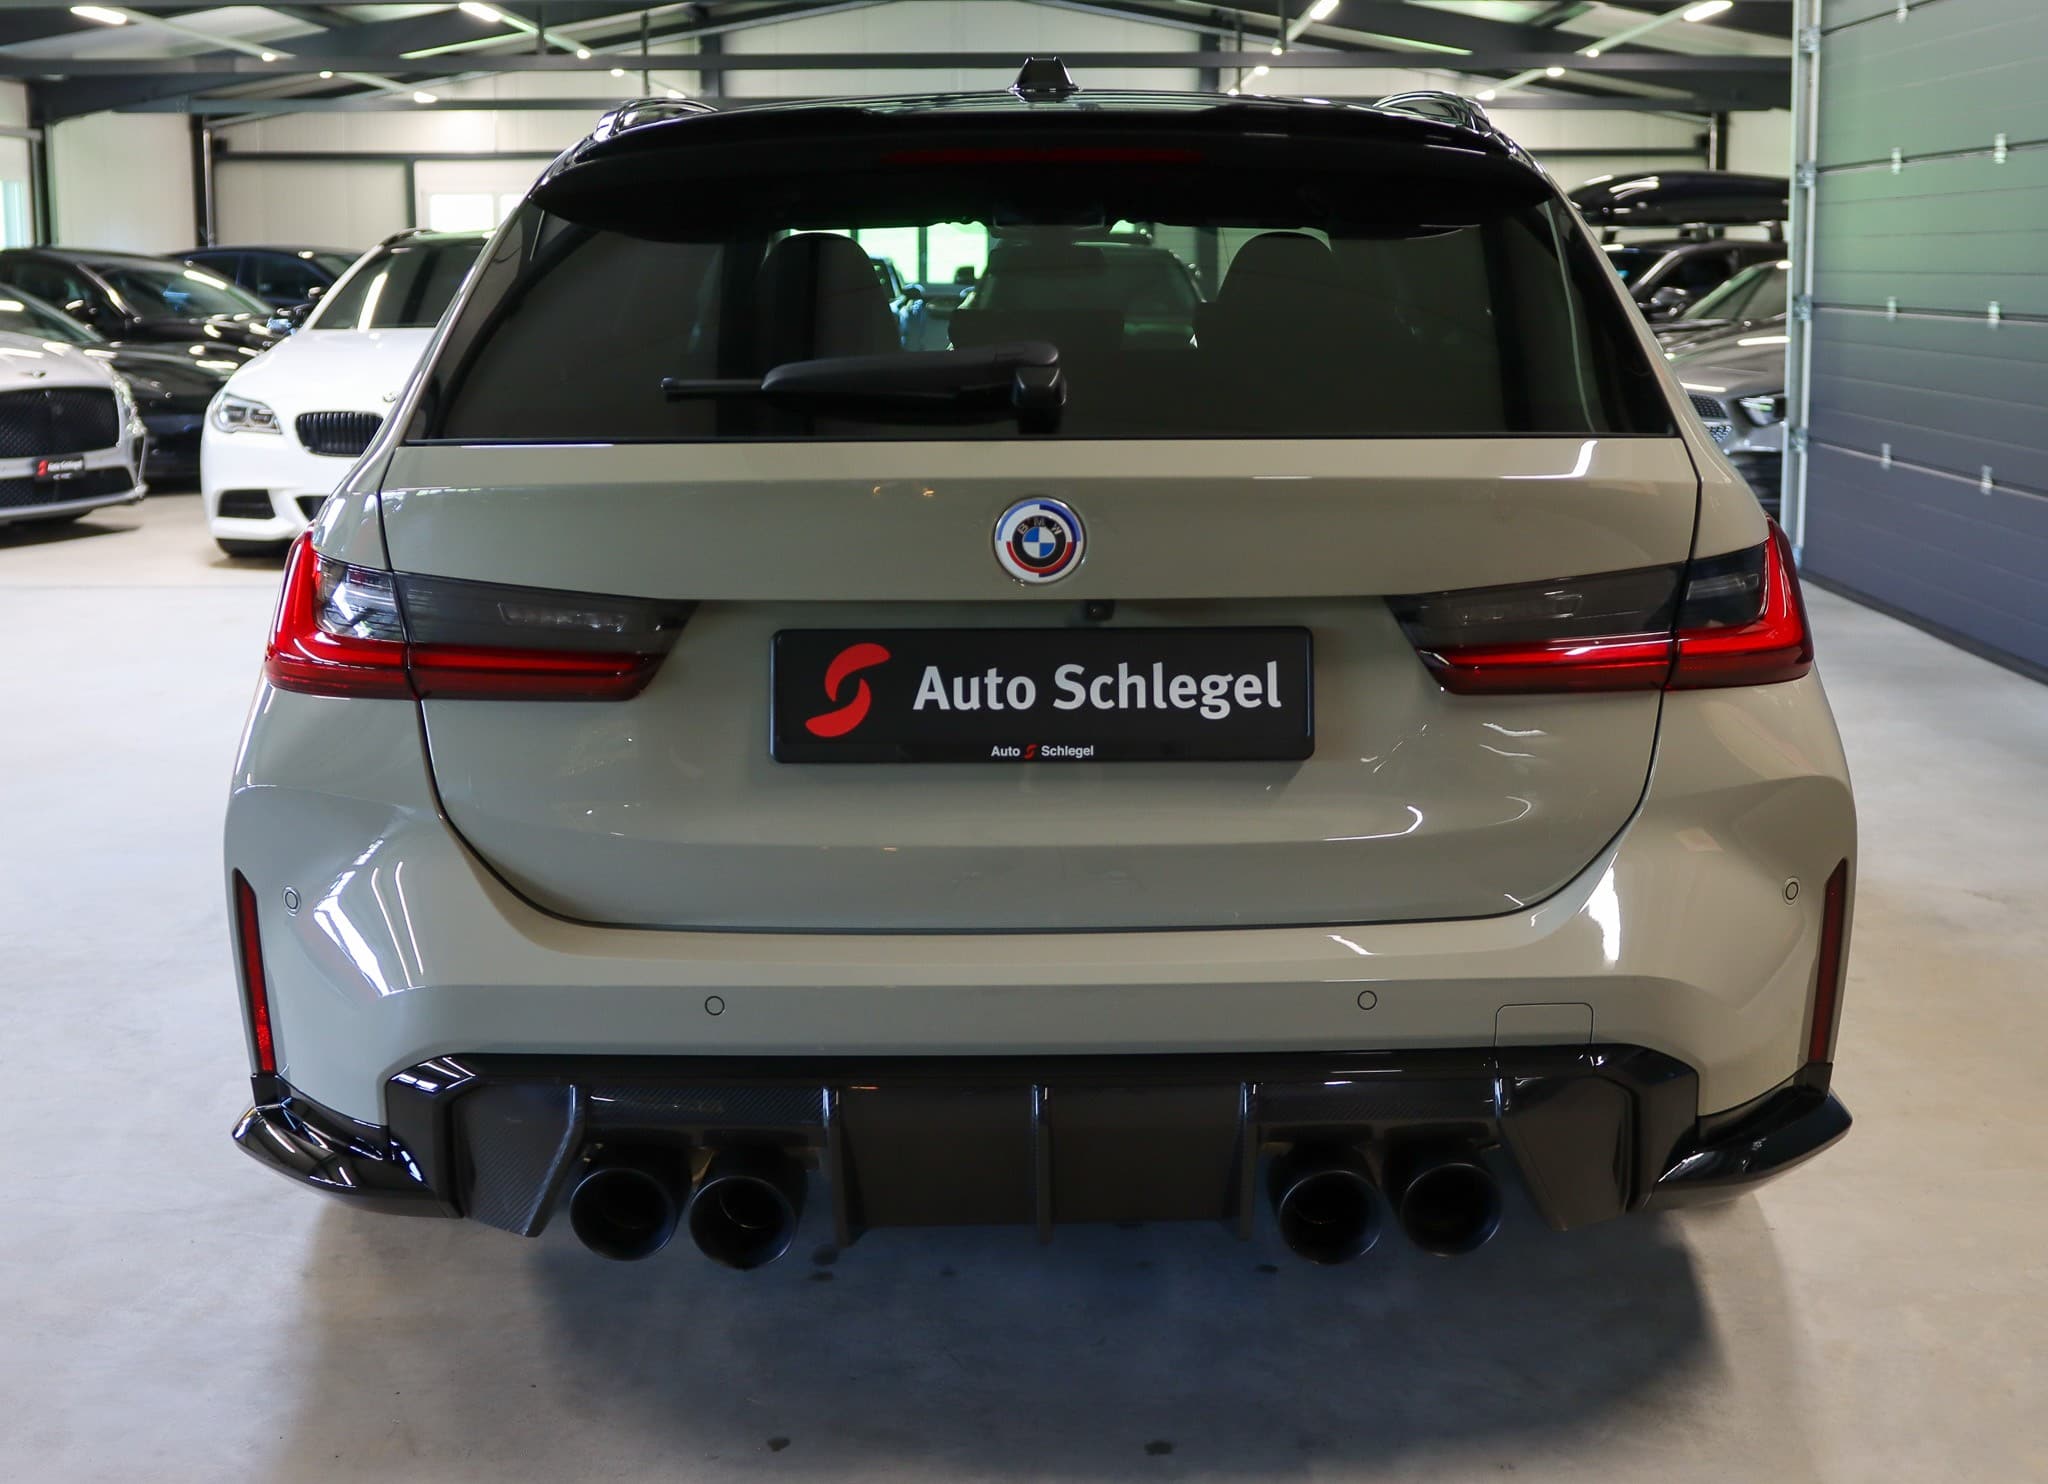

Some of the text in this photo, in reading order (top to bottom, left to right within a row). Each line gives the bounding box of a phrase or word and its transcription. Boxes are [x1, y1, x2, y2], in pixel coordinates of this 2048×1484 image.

[1017, 517, 1062, 534] BMW
[913, 661, 1282, 719] Auto Schlegel
[991, 745, 1094, 759] Auto Schlegel
